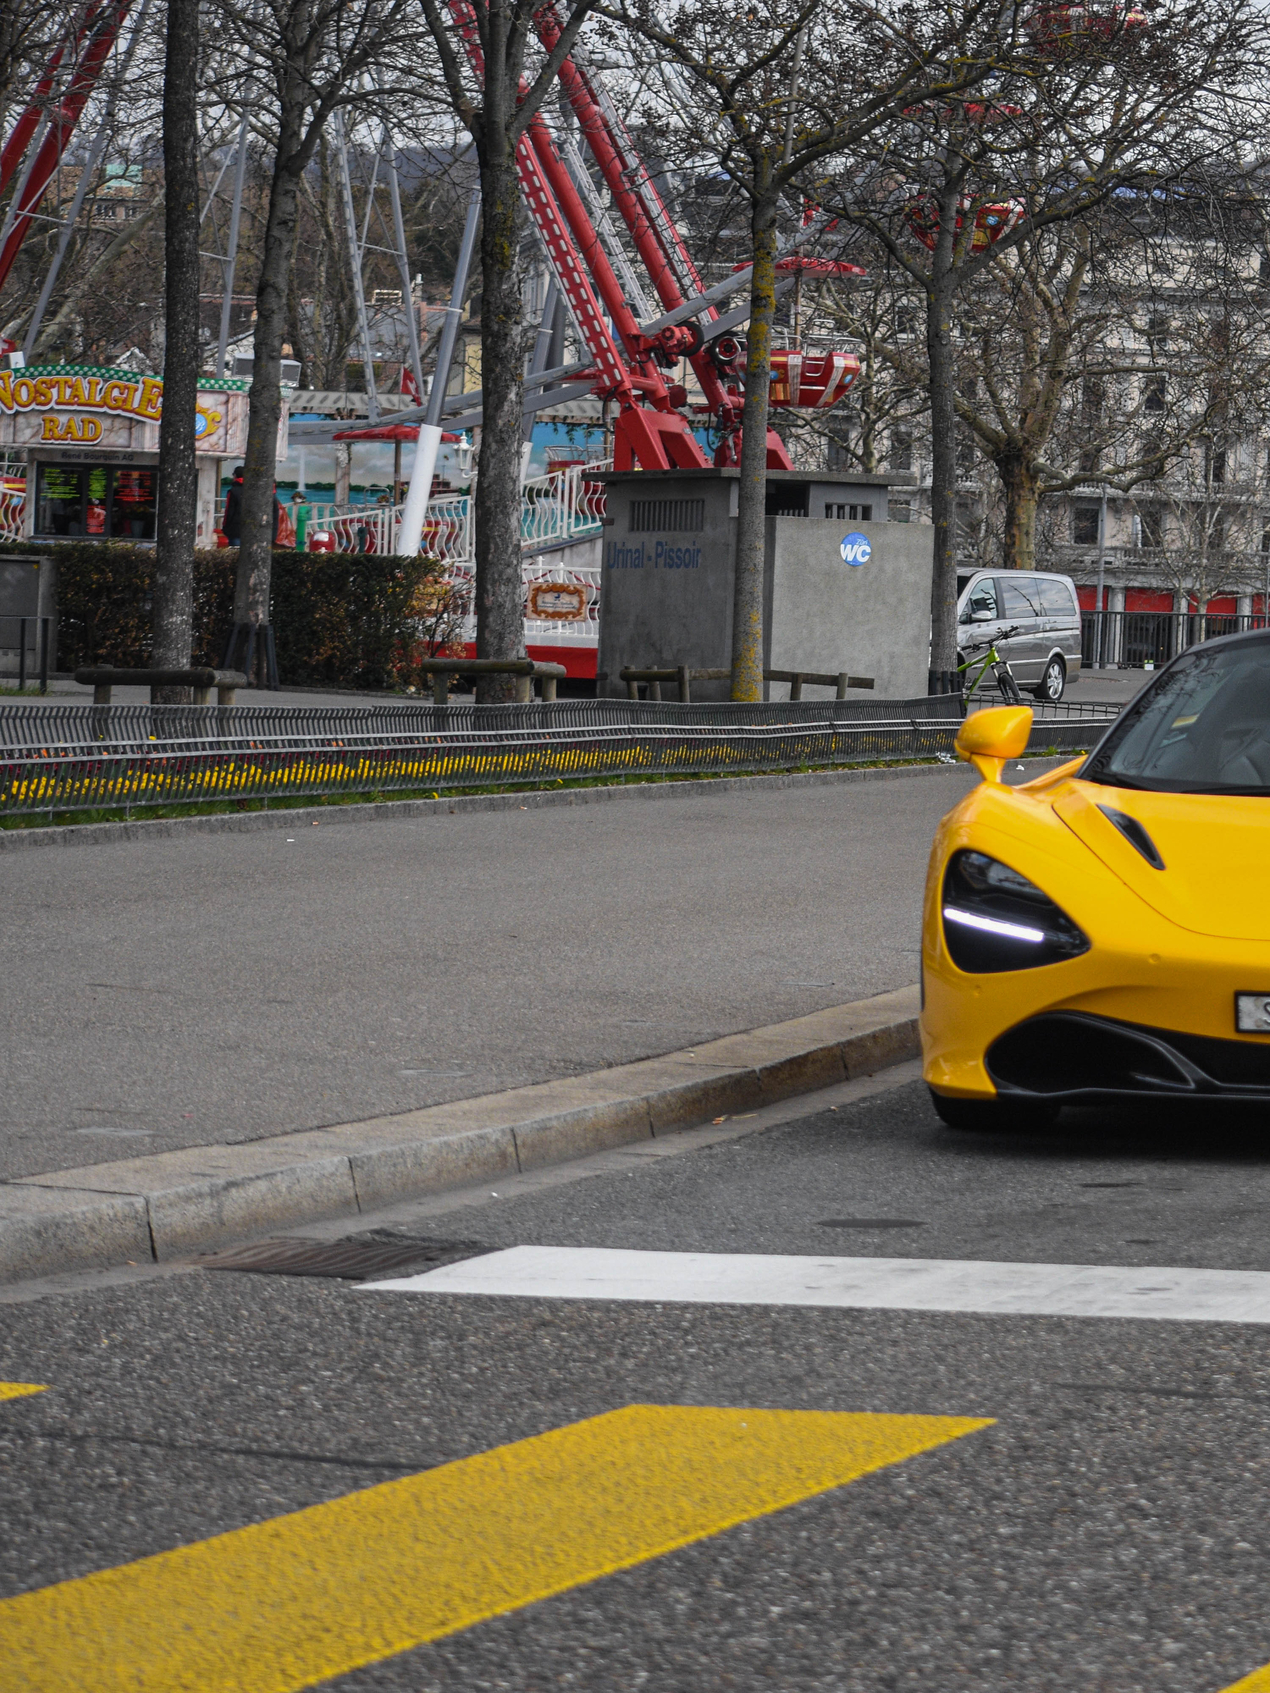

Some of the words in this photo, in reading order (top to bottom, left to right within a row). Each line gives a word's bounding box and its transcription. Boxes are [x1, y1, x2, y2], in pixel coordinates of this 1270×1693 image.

[41, 415, 103, 442] RAD
[607, 541, 644, 569] Urinal
[655, 541, 701, 569] Pissoir
[840, 543, 871, 563] WC
